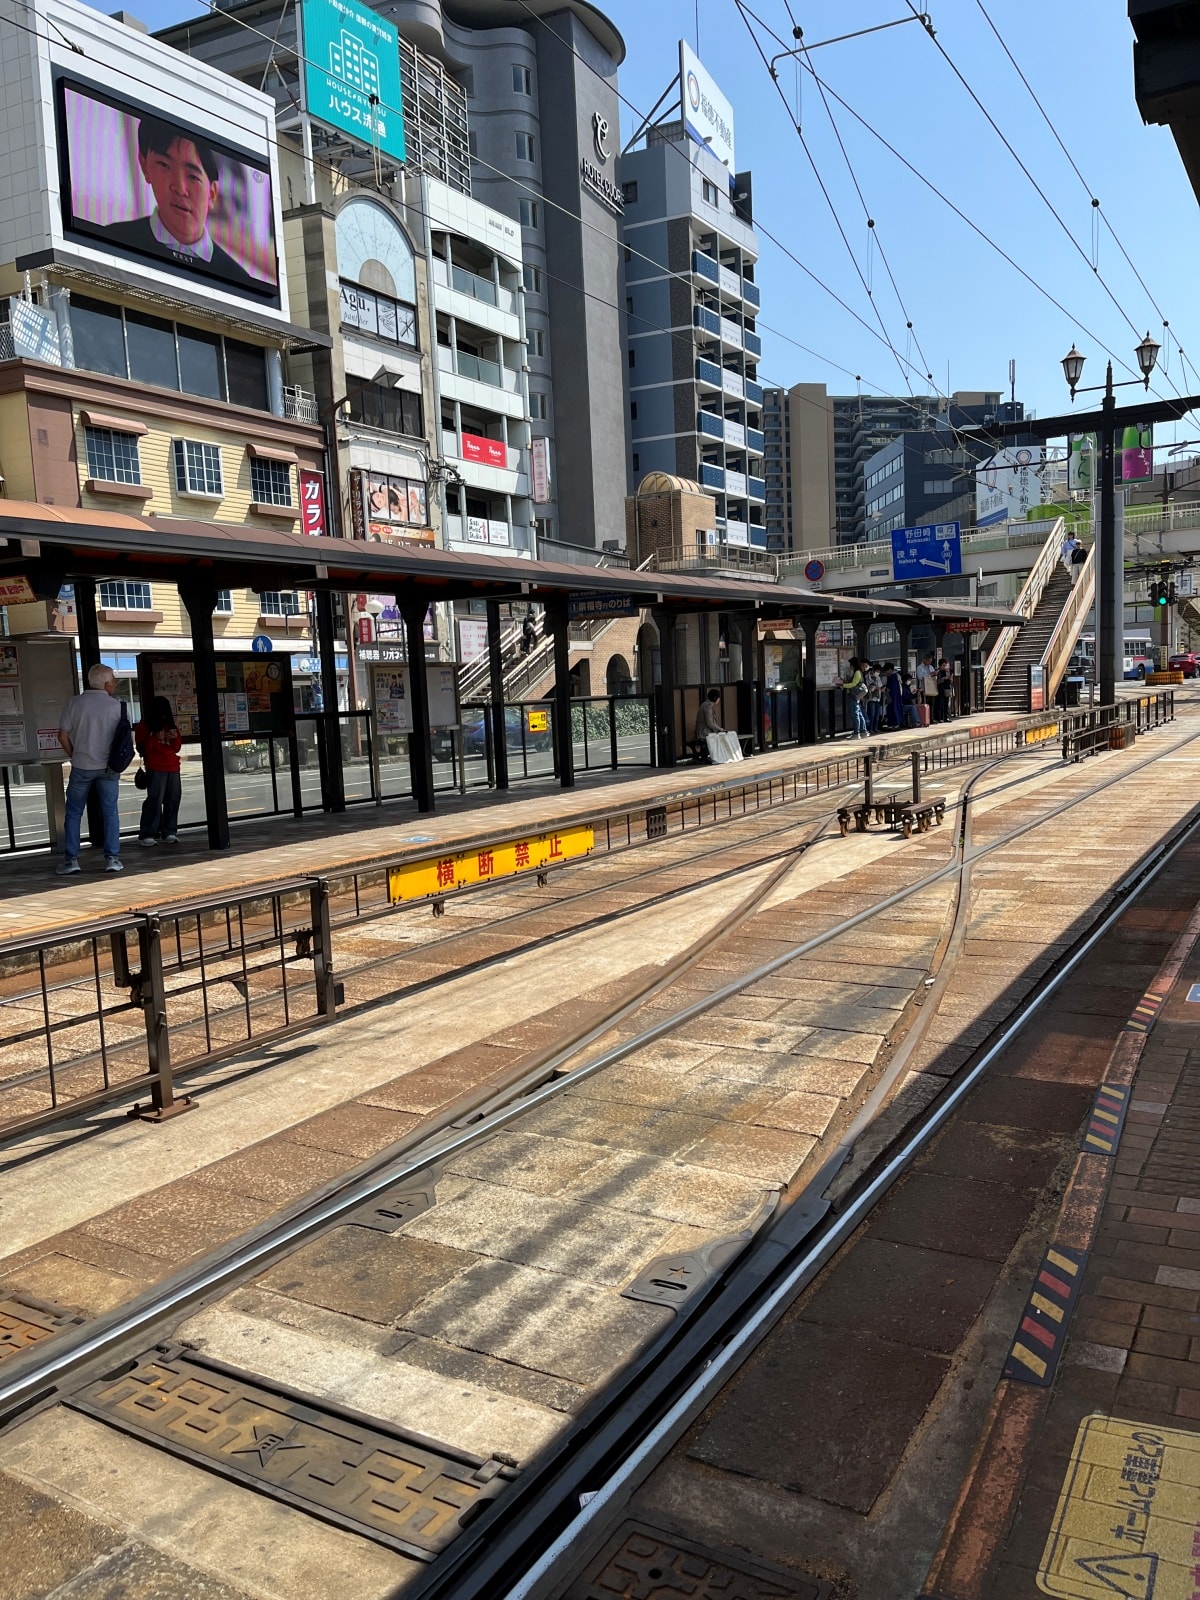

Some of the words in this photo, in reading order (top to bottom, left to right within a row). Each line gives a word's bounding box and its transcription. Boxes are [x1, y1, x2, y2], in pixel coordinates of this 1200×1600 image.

[582, 158, 604, 189] HOTEL
[340, 286, 370, 312] Agu.
[359, 650, 379, 660] 補聴器
[436, 834, 563, 888] 横断禁止
[1110, 1431, 1164, 1545] ホームと電車との
